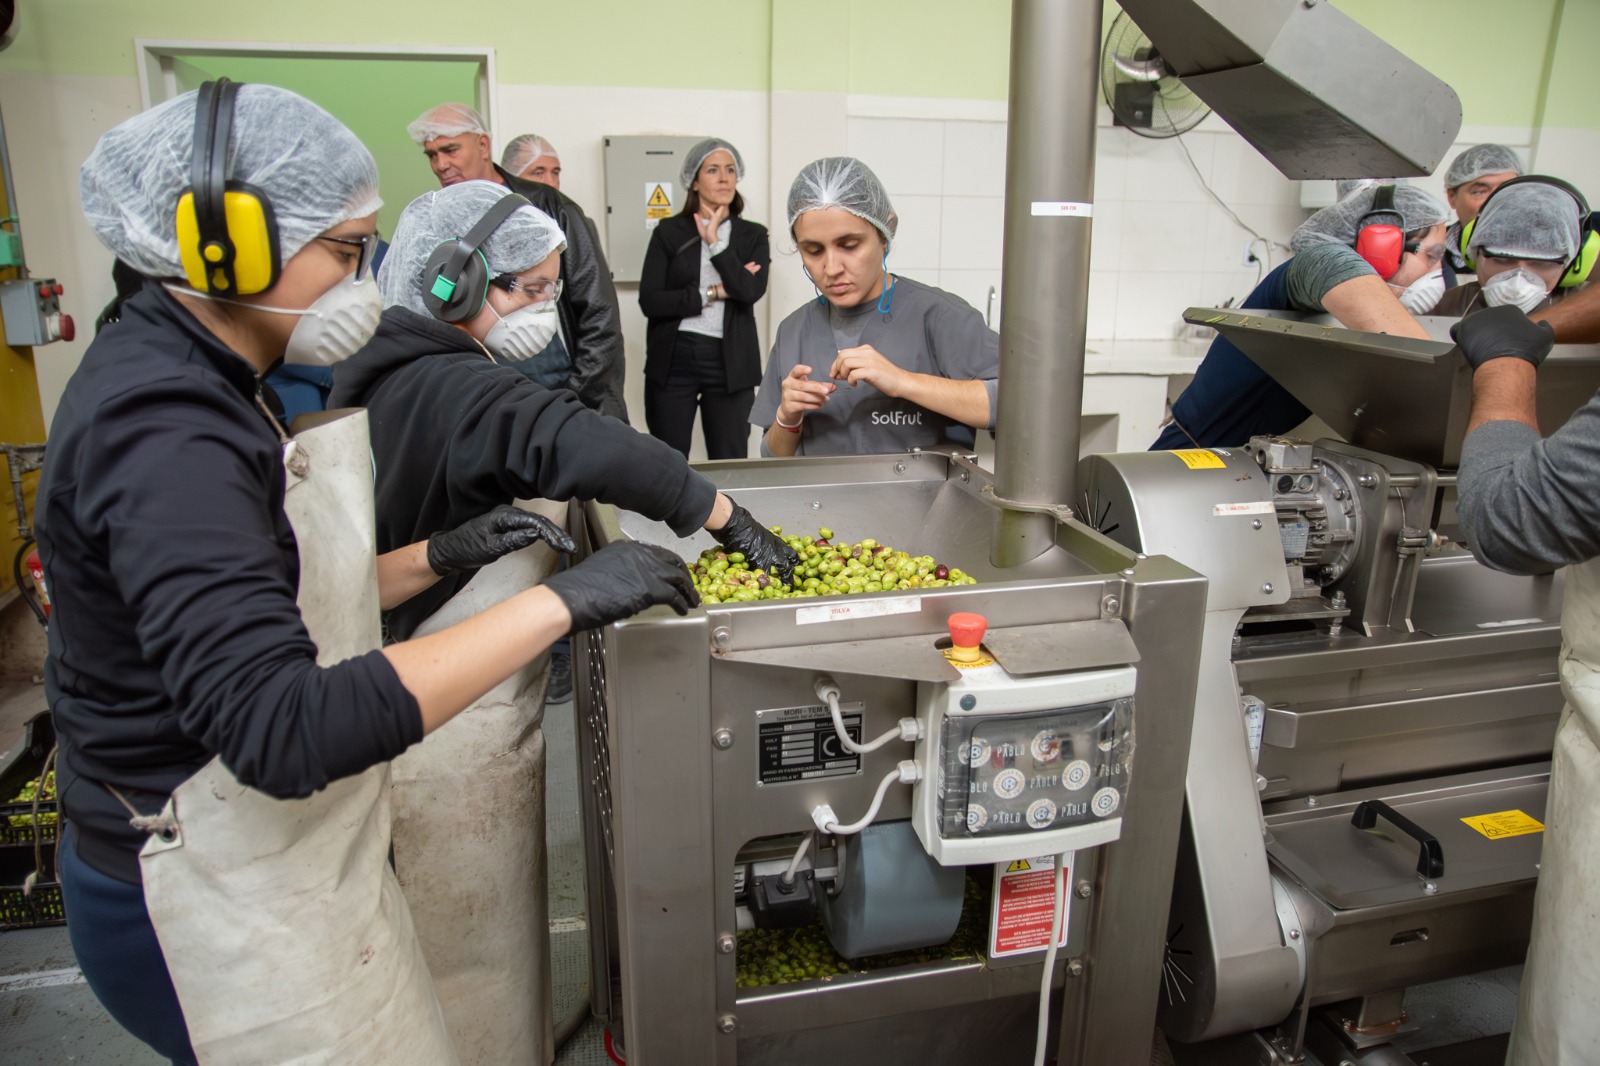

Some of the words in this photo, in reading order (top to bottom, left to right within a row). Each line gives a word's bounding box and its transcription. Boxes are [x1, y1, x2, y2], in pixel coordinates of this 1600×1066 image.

[871, 411, 922, 426] SolFrut
[996, 743, 1025, 758] PABLO
[993, 810, 1021, 824] PABLO
[1061, 802, 1087, 817] PABLO
